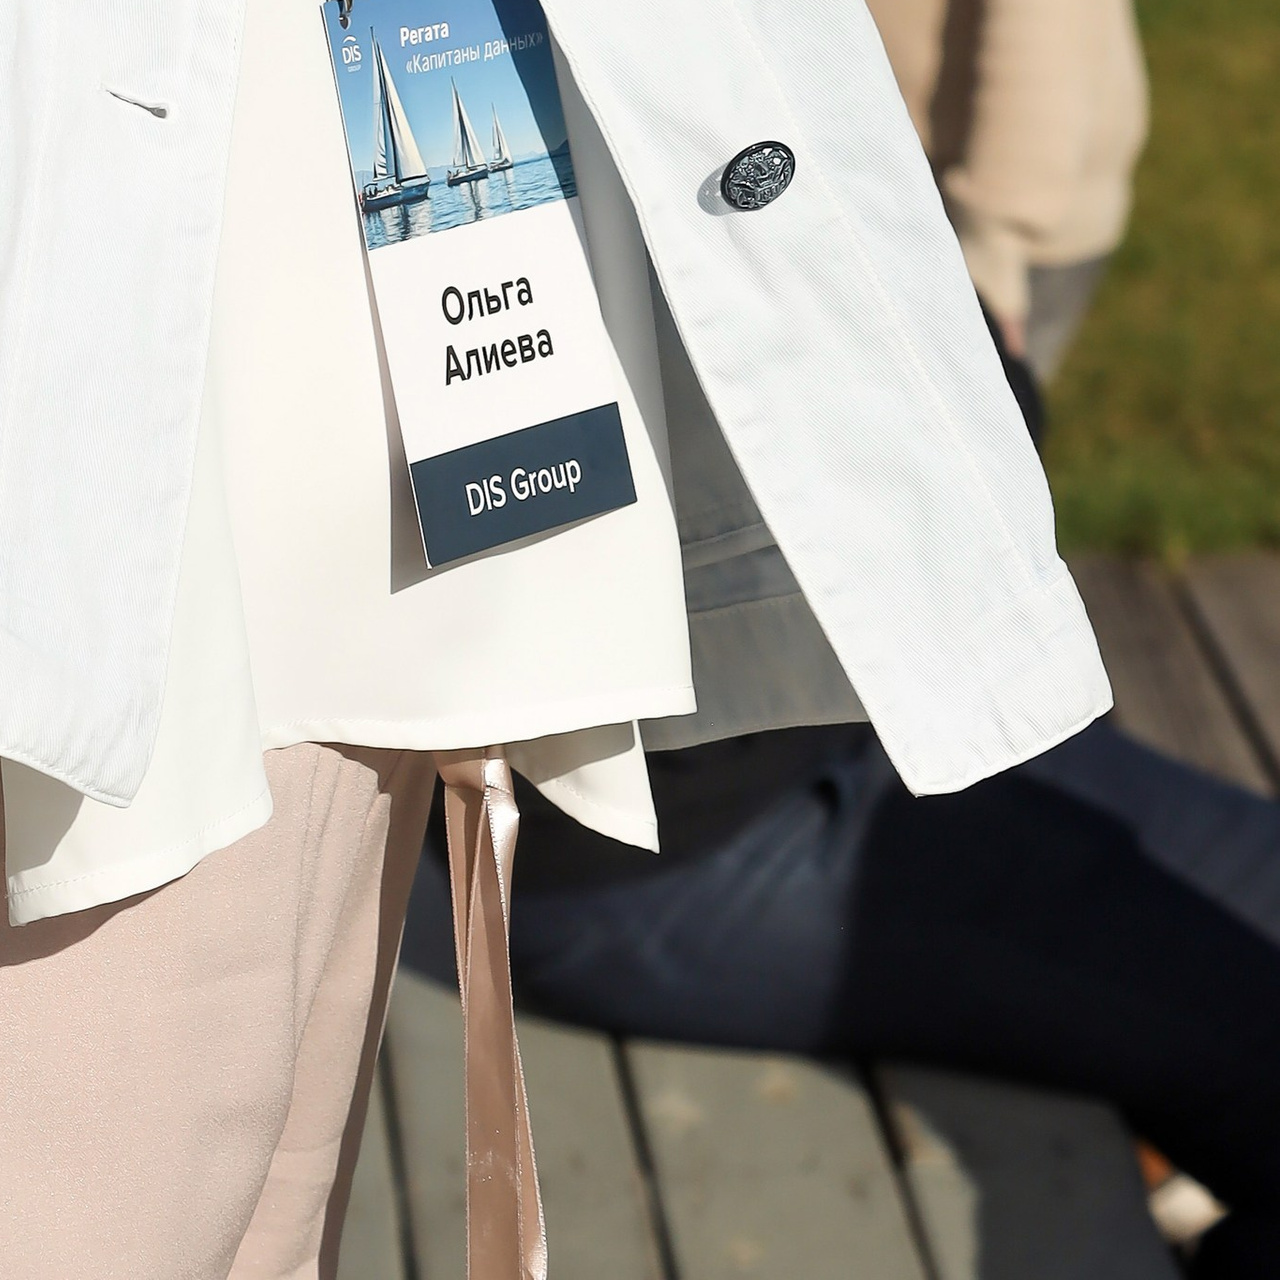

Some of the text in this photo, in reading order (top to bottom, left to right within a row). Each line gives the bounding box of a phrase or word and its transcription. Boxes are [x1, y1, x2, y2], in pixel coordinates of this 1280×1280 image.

[342, 44, 362, 64] DIS
[399, 22, 450, 47] Регата
[406, 31, 543, 74] «Капитаны данных»
[441, 277, 534, 325] Ольга
[445, 329, 554, 386] Алиева
[465, 458, 582, 517] DIS Group
